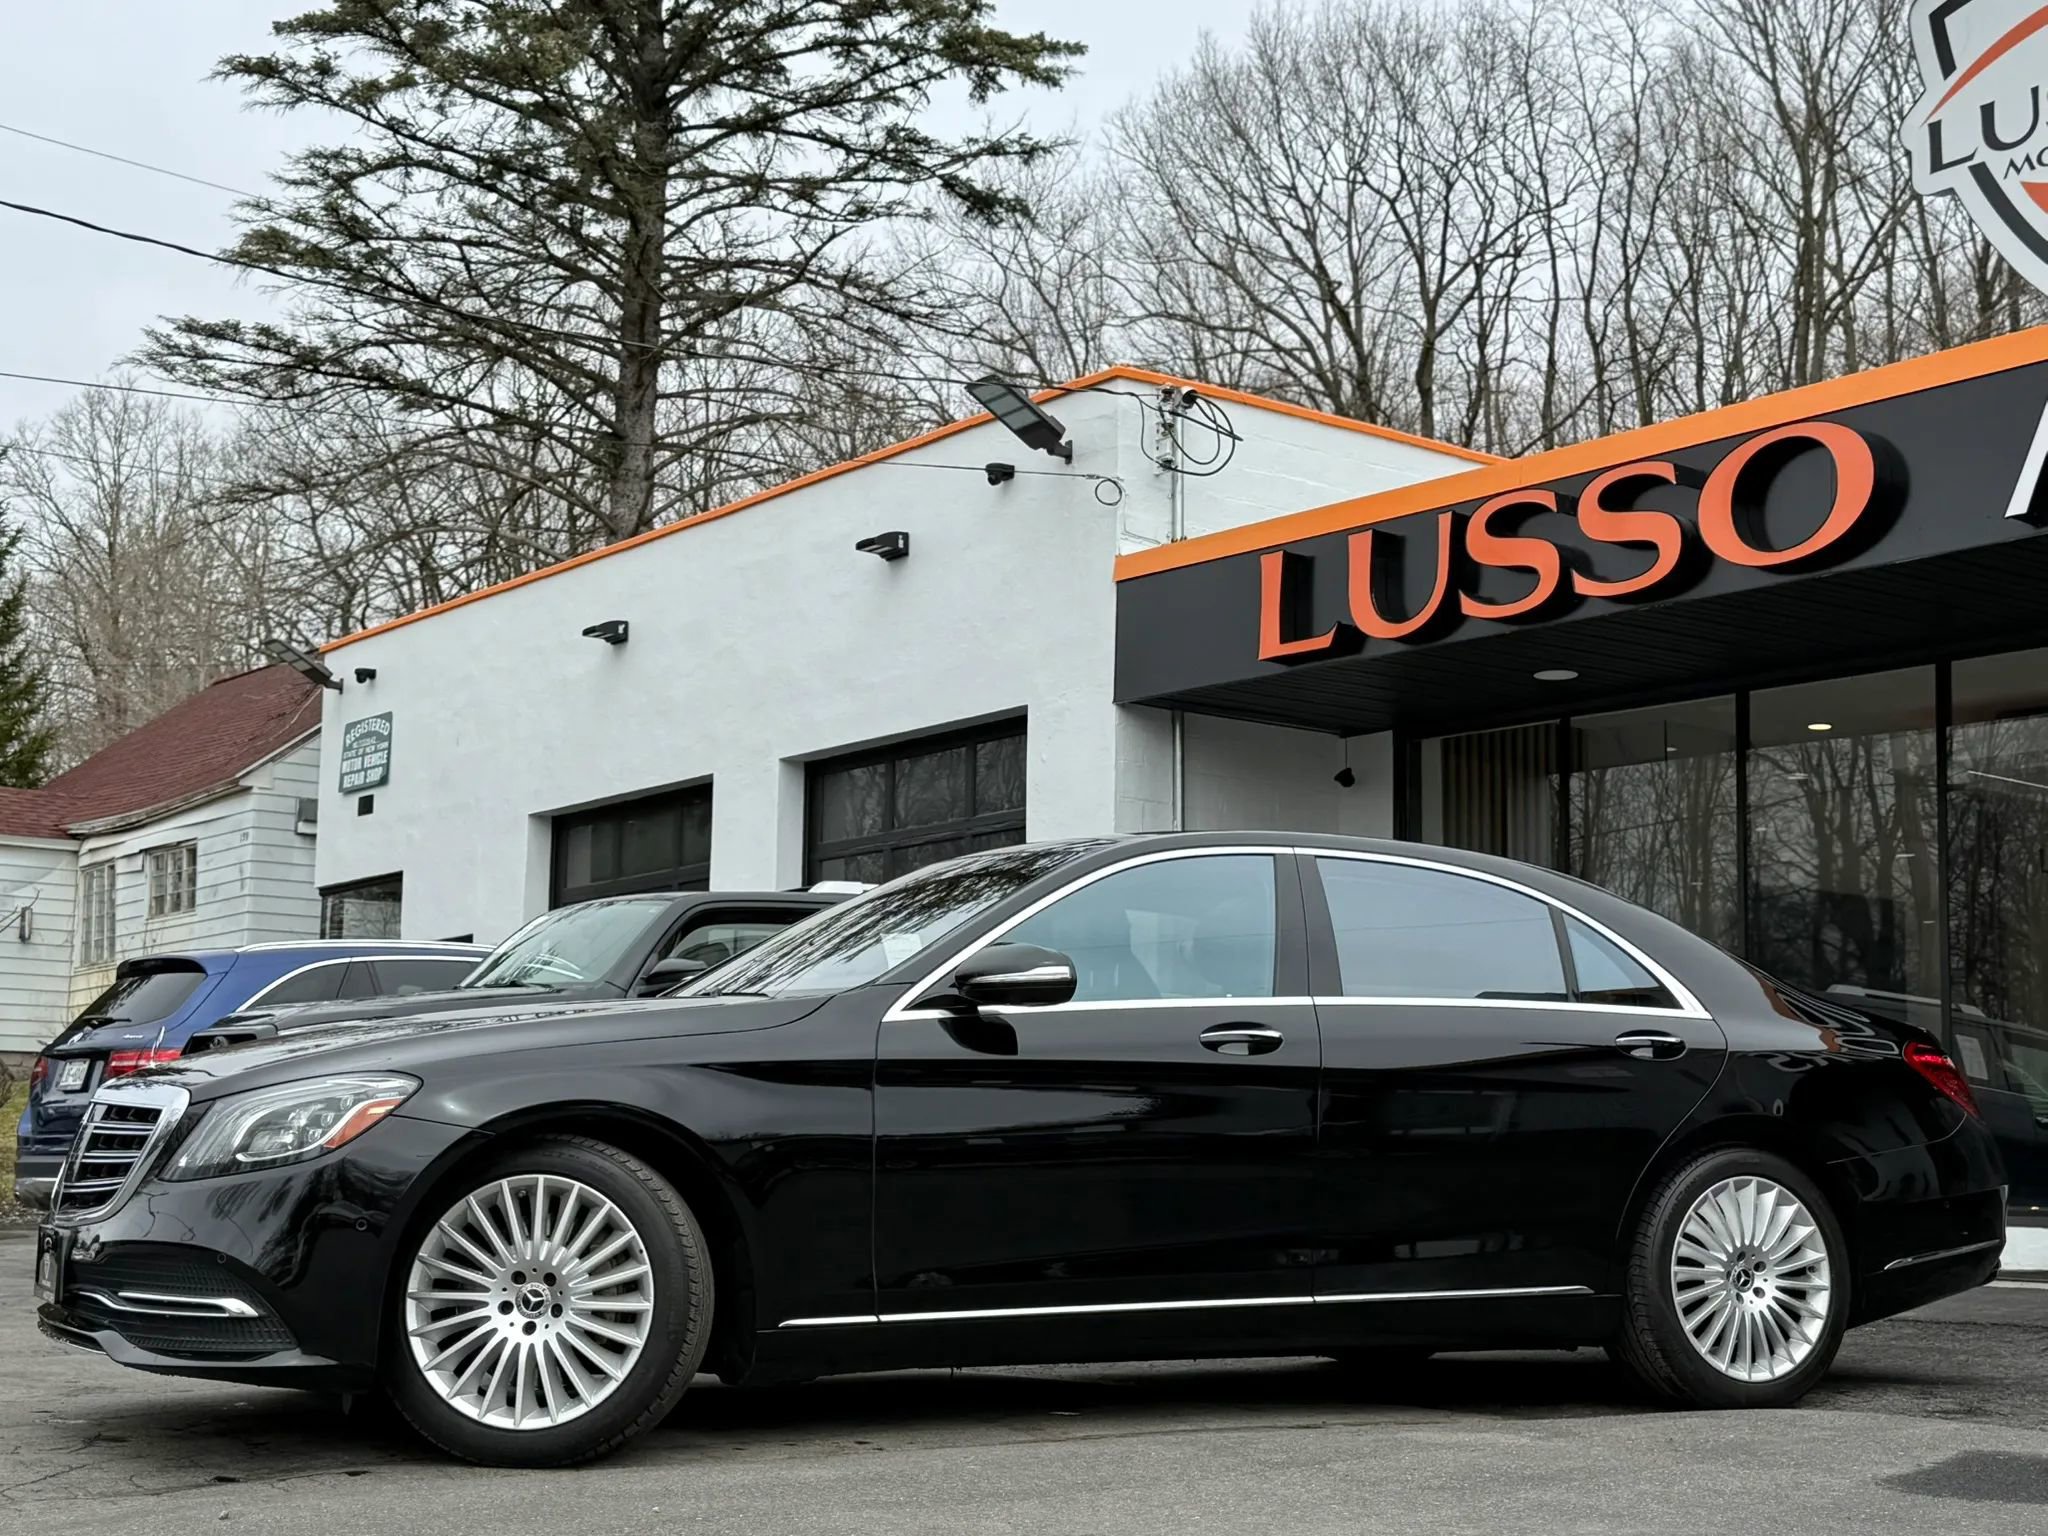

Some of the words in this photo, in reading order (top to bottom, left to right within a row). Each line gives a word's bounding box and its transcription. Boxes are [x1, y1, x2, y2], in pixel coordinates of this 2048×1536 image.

[1927, 85, 2048, 175] LU
[1259, 421, 1875, 661] LUSSO
[345, 718, 391, 747] REGISTERED
[364, 750, 389, 768] VEHICLE
[343, 771, 365, 788] REPAIR
[366, 767, 383, 783] SHOP
